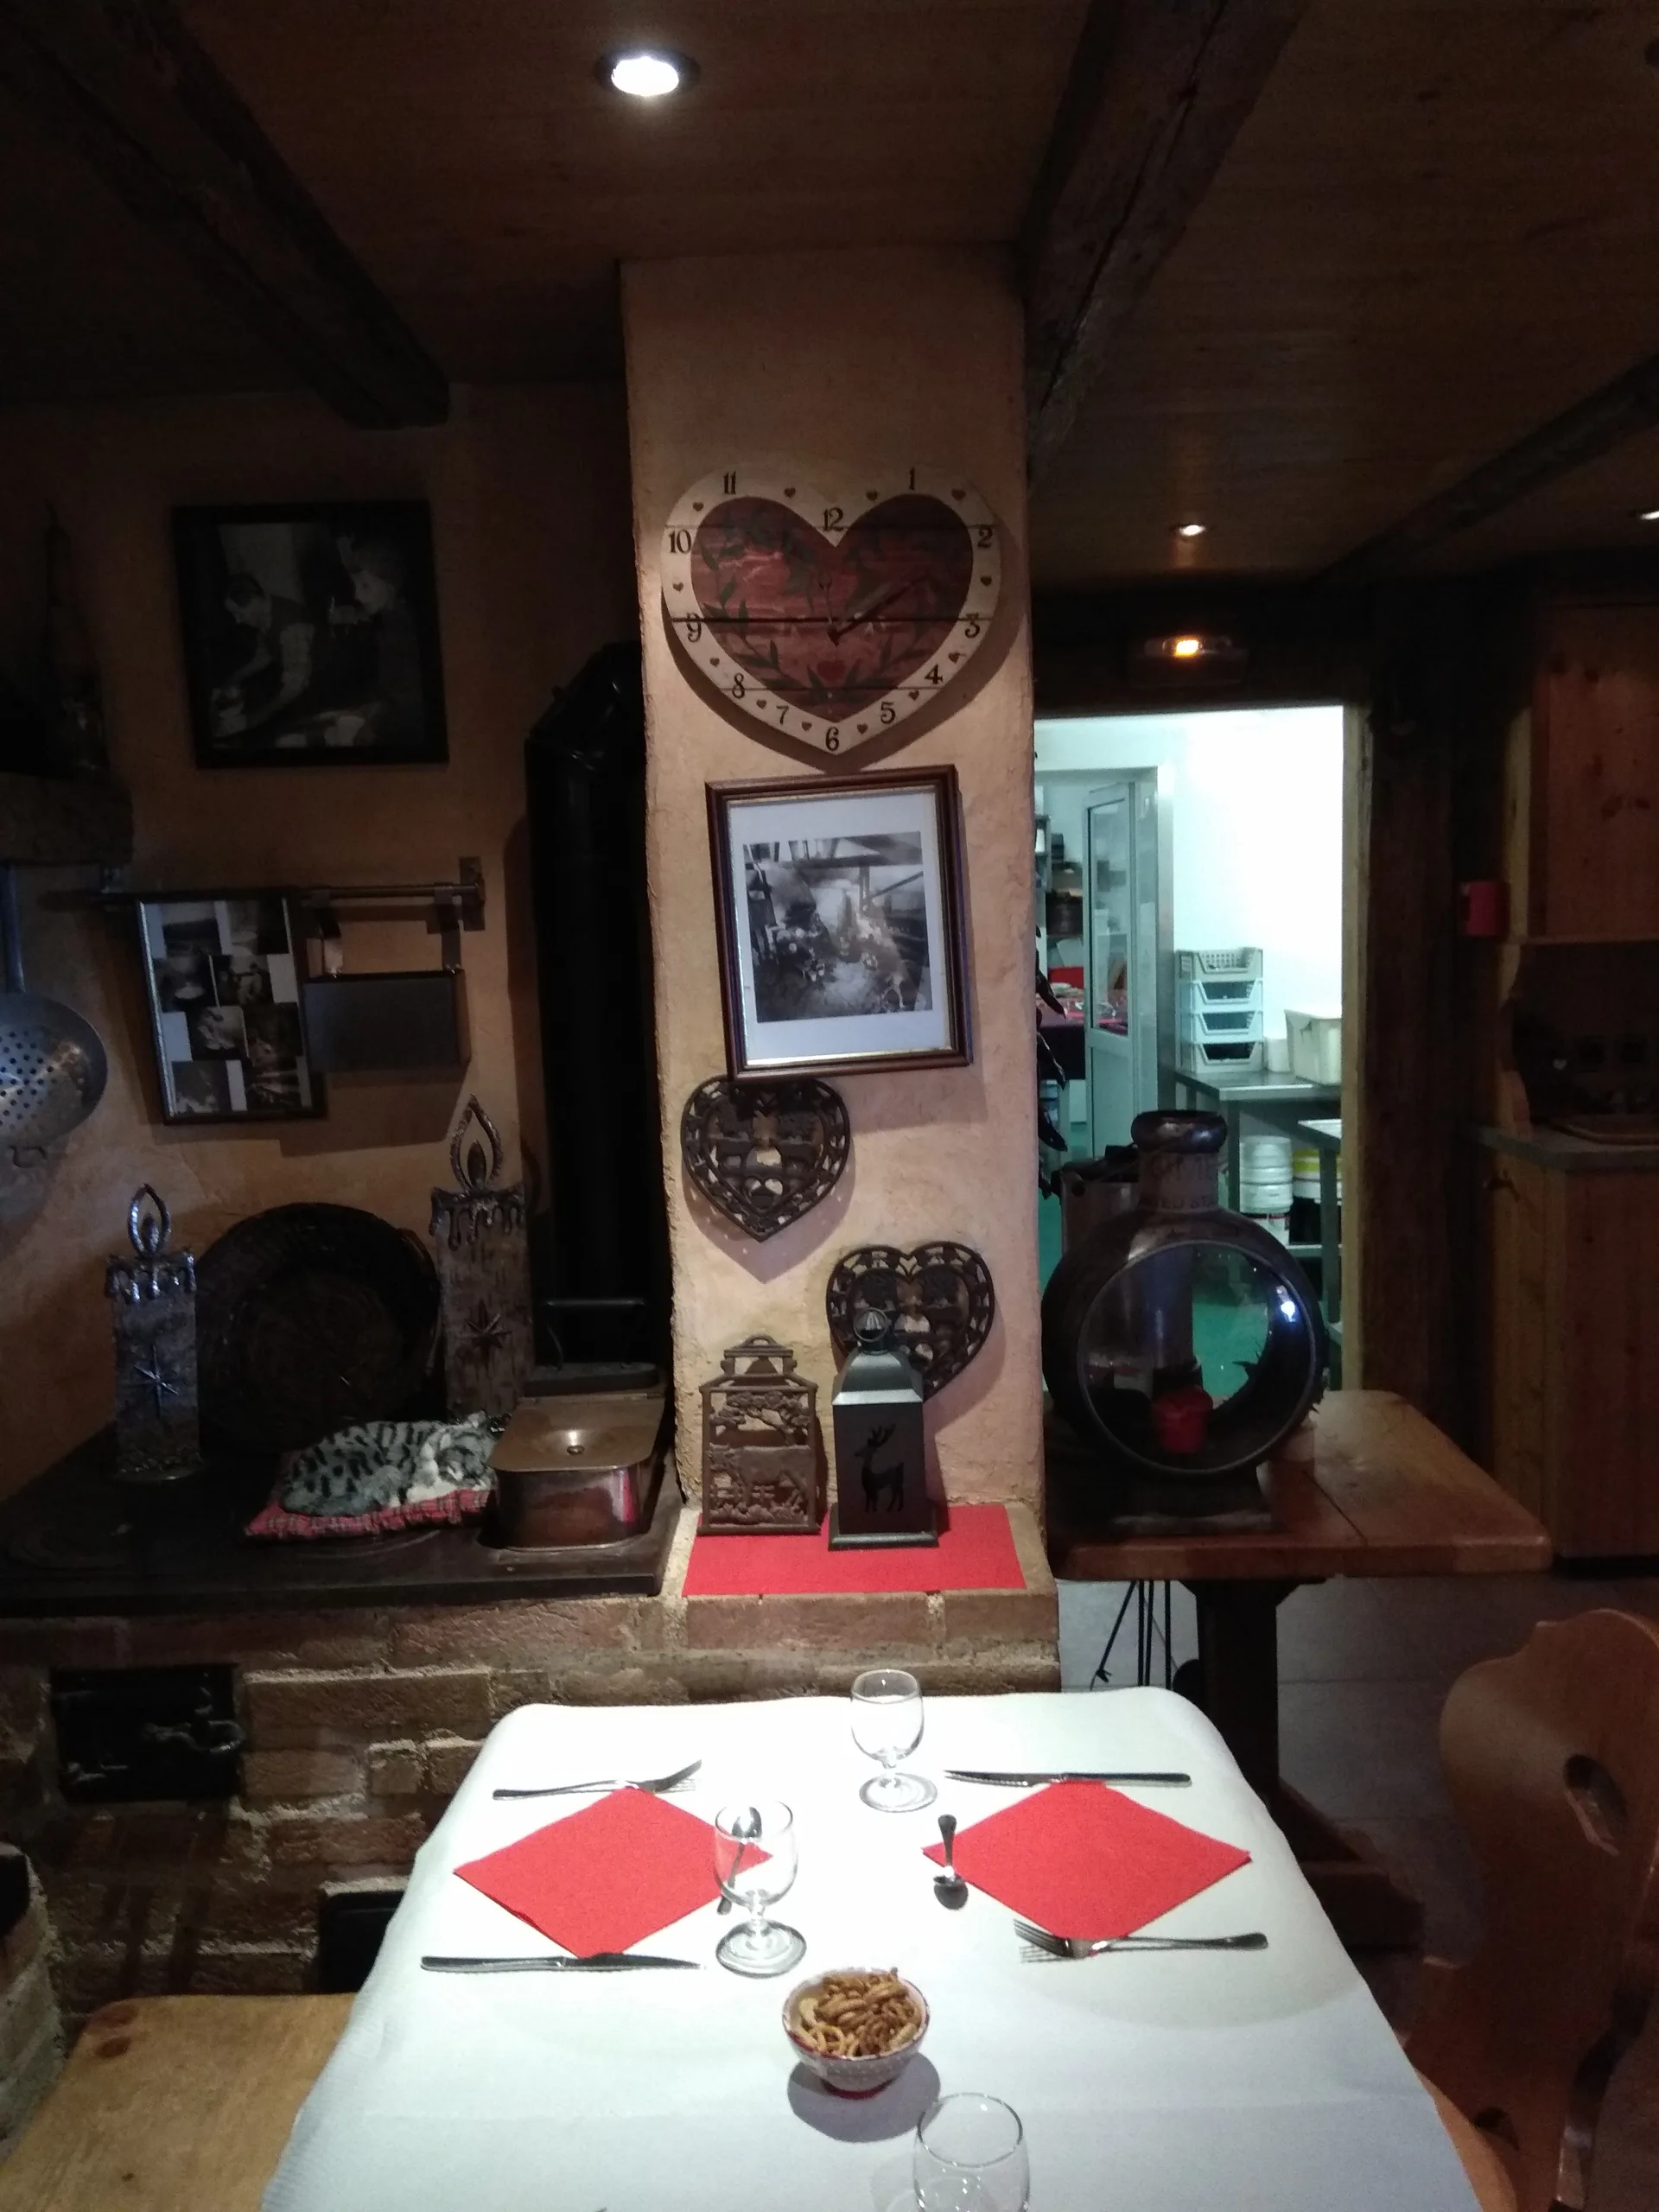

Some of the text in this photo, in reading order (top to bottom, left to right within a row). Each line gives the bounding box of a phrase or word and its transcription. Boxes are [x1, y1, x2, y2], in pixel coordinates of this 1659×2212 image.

[722, 471, 737, 495] 11
[908, 467, 916, 491] 1
[822, 508, 844, 531] 12
[668, 529, 692, 554] 10
[976, 528, 994, 548] 2
[686, 613, 703, 642] 9
[963, 613, 982, 639] 3
[732, 673, 746, 699] 8
[925, 664, 944, 685] 4
[776, 705, 790, 725] 7
[880, 702, 896, 724] 5
[825, 728, 840, 752] 6
